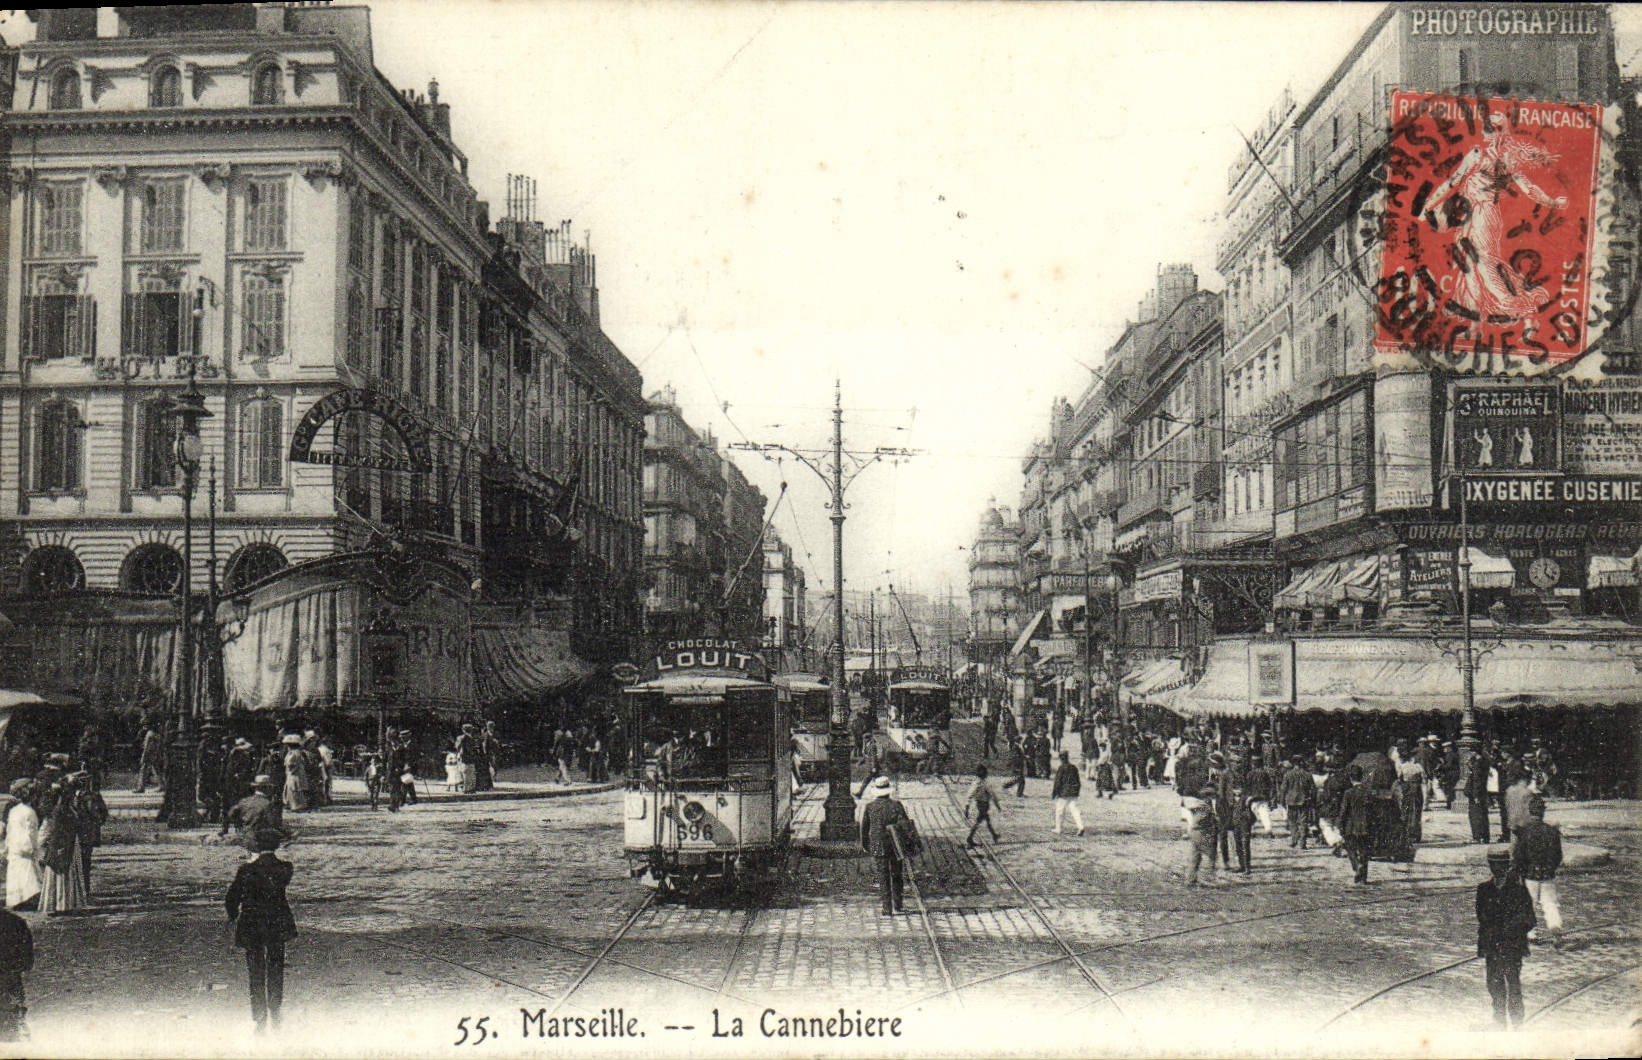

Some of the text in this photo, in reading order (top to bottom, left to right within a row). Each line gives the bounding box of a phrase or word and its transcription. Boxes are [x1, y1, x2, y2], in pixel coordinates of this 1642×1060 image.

[1411, 9, 1597, 36] PHOTOGRAPHIE
[1558, 260, 1580, 342] POSTES
[1478, 407, 1537, 417] QUINQUINA
[1409, 567, 1453, 582] ATELIERS
[668, 638, 738, 650] CHOCOLAT
[656, 651, 751, 671] LOUIT
[900, 671, 941, 681] LOUIT
